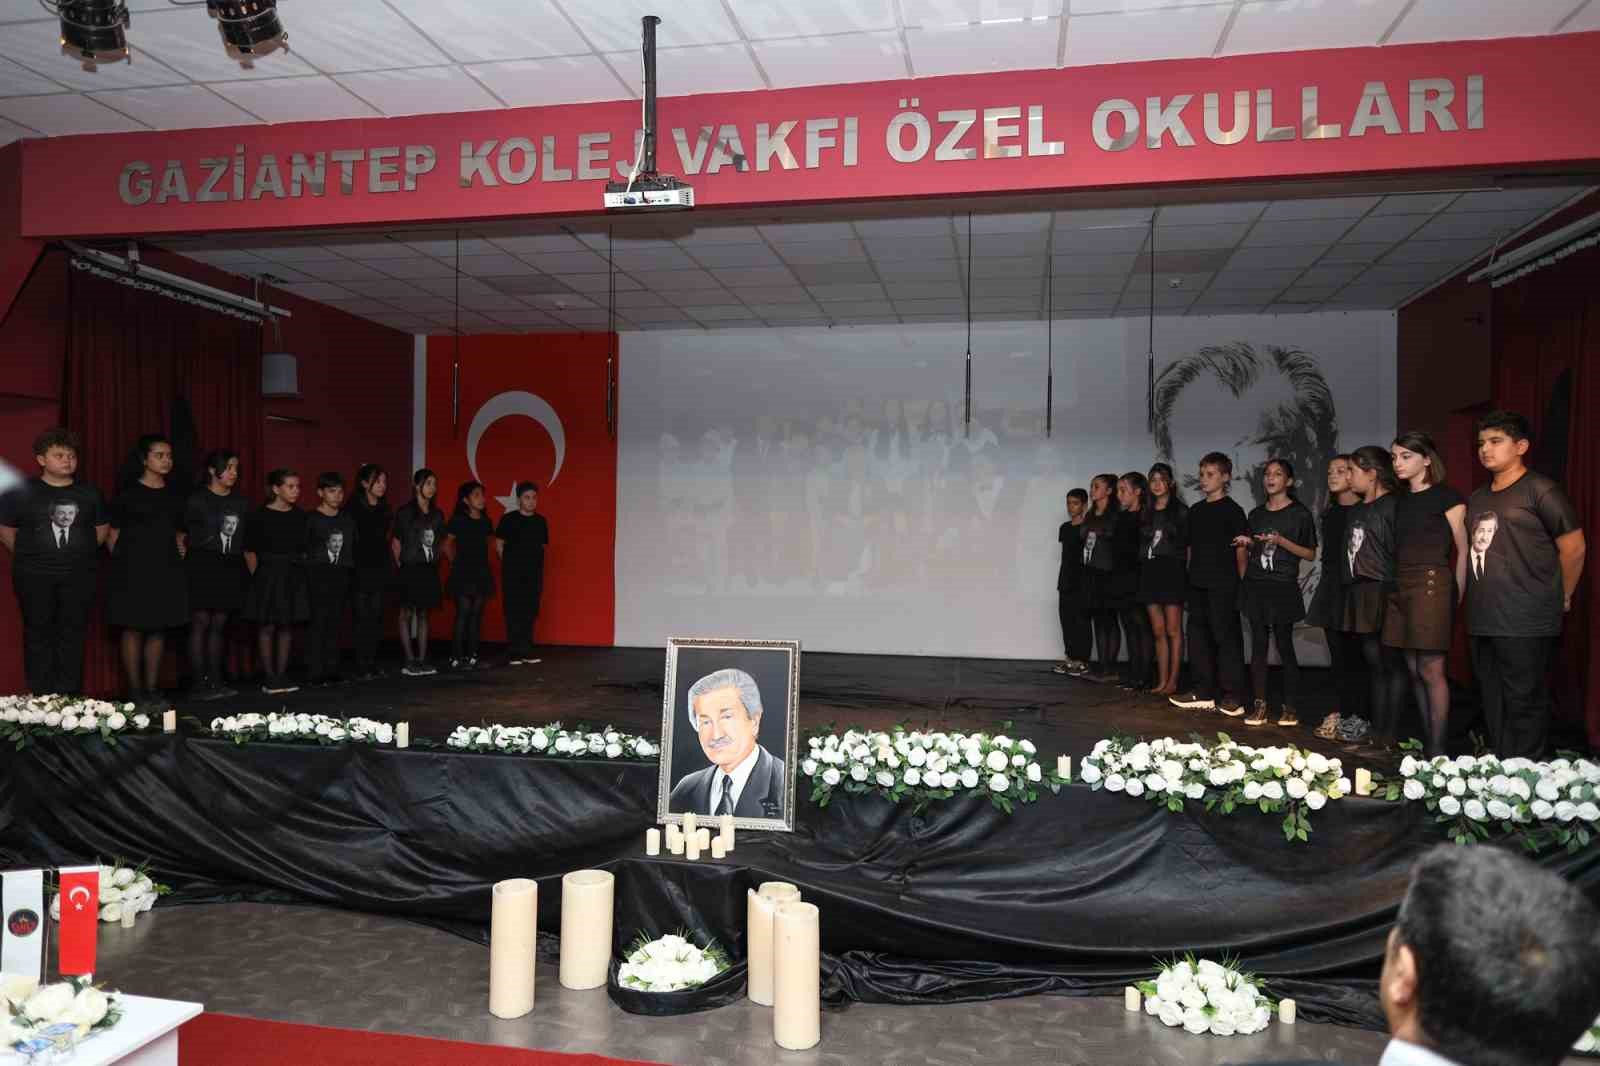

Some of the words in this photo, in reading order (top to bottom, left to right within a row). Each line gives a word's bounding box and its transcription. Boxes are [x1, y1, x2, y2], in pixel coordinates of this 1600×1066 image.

[118, 144, 437, 206] GAZİANTEP
[671, 116, 859, 174] VAKFI
[885, 97, 1065, 163] ÖZEL
[1091, 75, 1486, 152] OKULLARI
